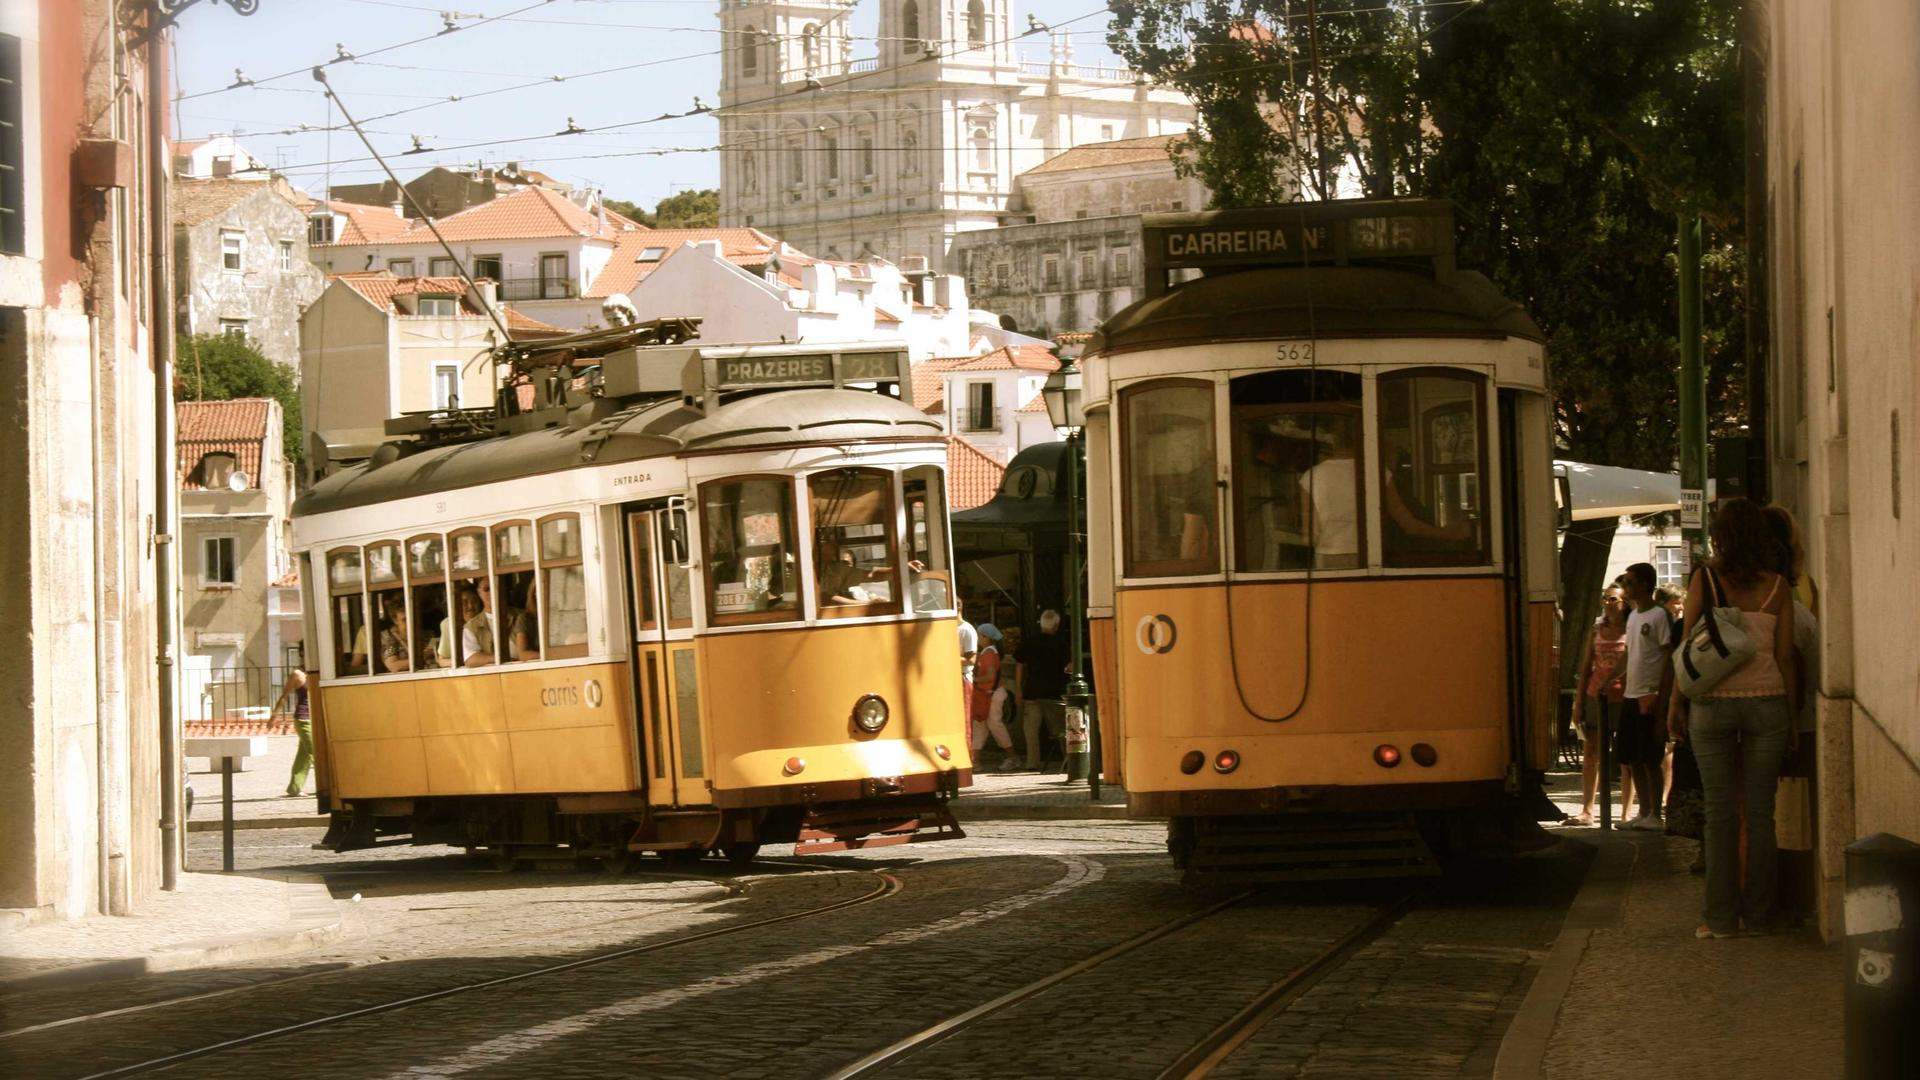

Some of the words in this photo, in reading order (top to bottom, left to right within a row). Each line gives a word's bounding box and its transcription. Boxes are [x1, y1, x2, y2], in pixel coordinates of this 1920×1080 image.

[1168, 229, 1287, 255] CARREIRA
[1277, 344, 1311, 360] 562
[727, 359, 824, 380] PRAZERES
[851, 357, 885, 377] 28
[614, 473, 652, 486] ENTRADA
[541, 678, 578, 707] carris
